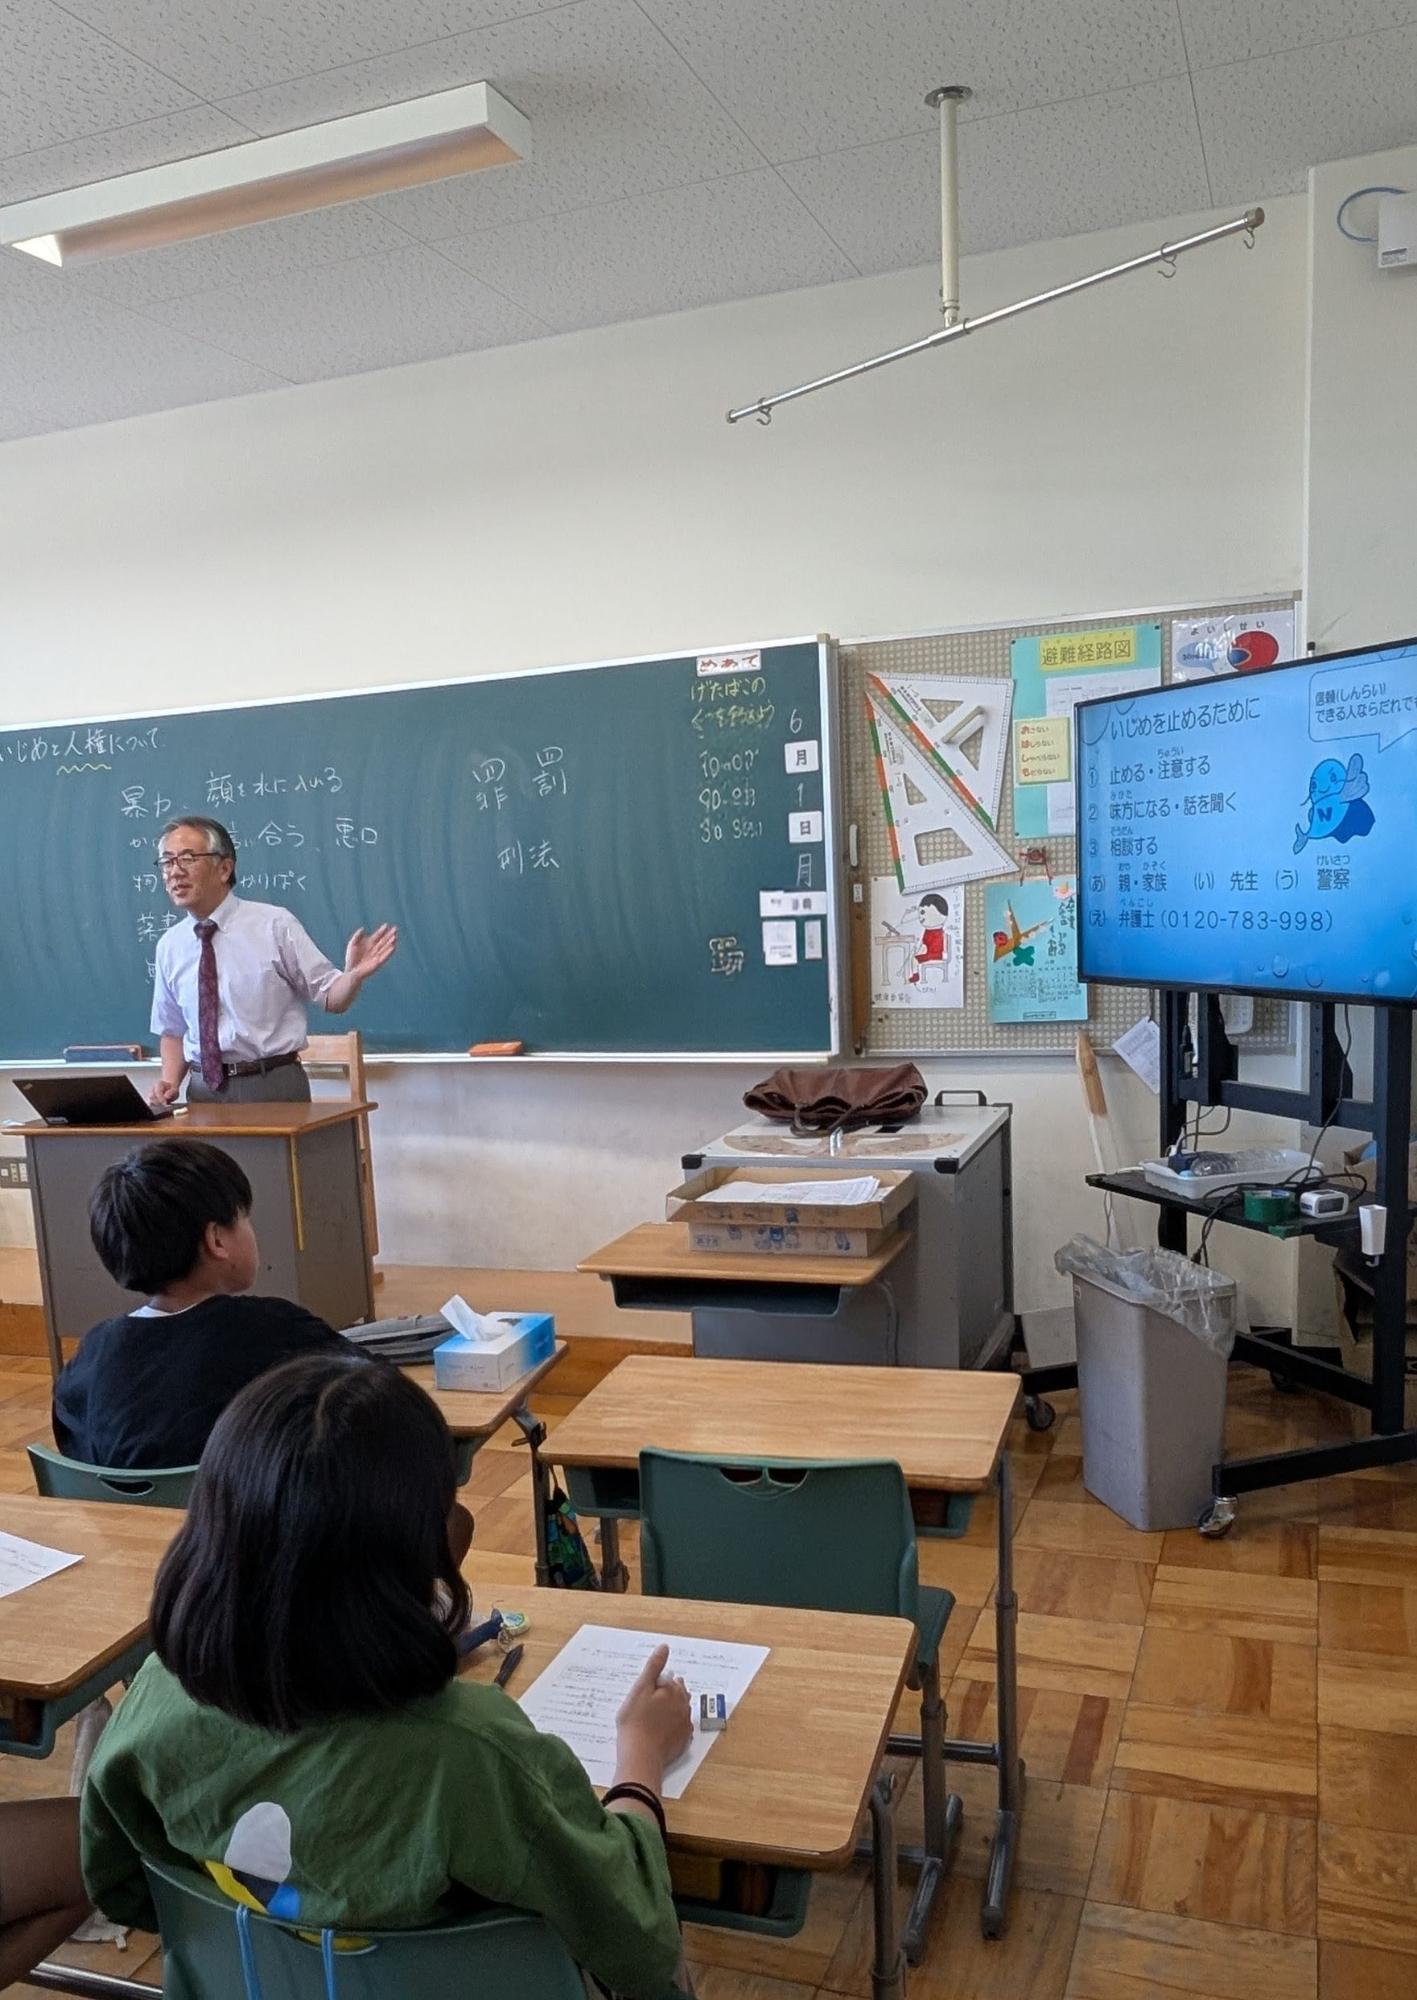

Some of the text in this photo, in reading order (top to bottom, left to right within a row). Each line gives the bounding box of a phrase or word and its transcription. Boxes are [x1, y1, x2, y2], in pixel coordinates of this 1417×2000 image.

[1190, 620, 1265, 637] よいしせい
[699, 654, 759, 673] めあて
[1041, 639, 1132, 667] 避難経路図
[691, 676, 767, 702] げたばこの
[1110, 697, 1262, 741] いじめを止めるために
[1315, 696, 1417, 724] できる人ならだれで
[796, 749, 808, 767] 月
[1109, 755, 1211, 786] 止める・注意する
[1109, 791, 1237, 820] 味方になる・話を聞く
[1316, 806, 1334, 823] N
[799, 820, 812, 836] 日
[1110, 836, 1159, 857] 相談する
[1118, 873, 1168, 893] 親・家族
[1194, 871, 1215, 891] (い)
[1230, 869, 1259, 892] 先生
[1275, 869, 1299, 891] (う)
[1317, 868, 1351, 891] 警察
